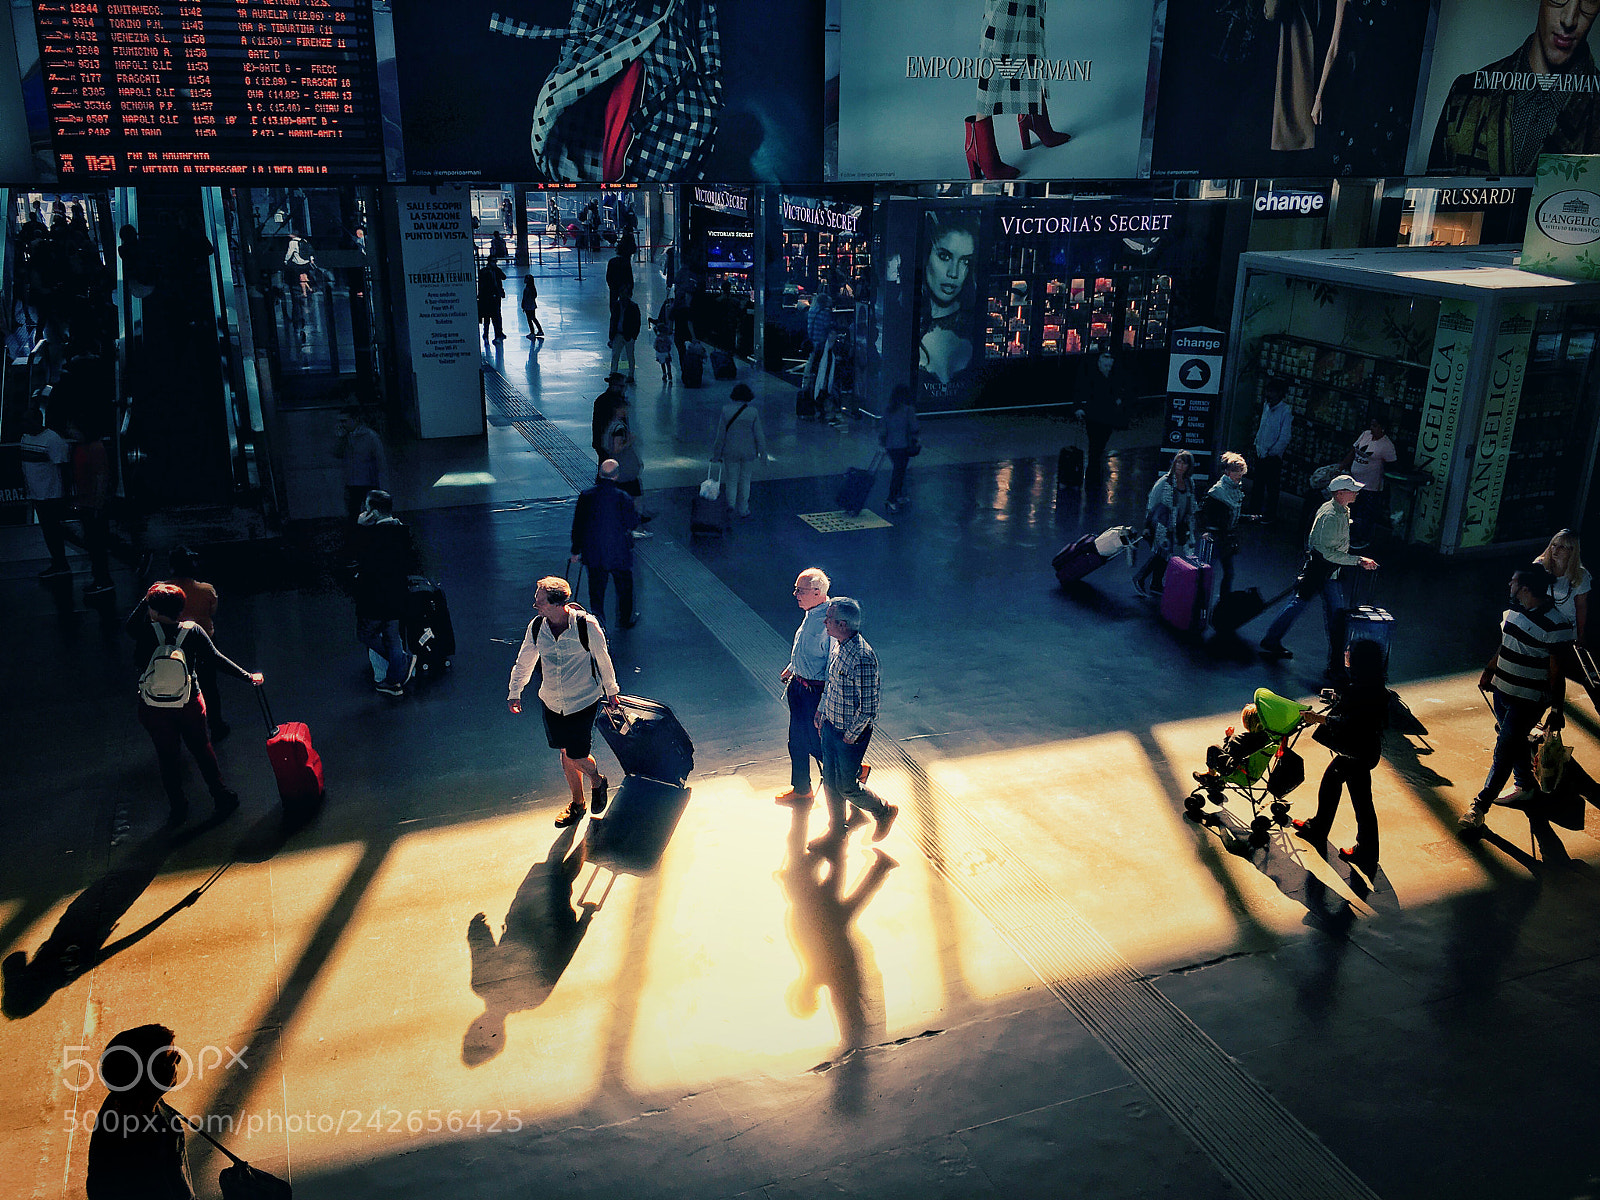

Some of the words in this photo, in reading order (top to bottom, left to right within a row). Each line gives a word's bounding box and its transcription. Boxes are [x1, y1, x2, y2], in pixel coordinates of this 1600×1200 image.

[109, 19, 141, 28] TORINO
[111, 33, 149, 42] VENEZIA
[297, 38, 332, 47] FIRENZE
[115, 61, 148, 69] NAPOLI
[905, 55, 996, 80] EMPORIO
[1019, 58, 1093, 82] ARMANI
[117, 74, 160, 83] FRASCATI
[1473, 70, 1537, 91] EMPORIO
[119, 88, 151, 96] NAPOLI
[122, 115, 154, 123] NAPOLI
[725, 191, 748, 211] SECRET
[1433, 187, 1518, 206] TRUSSARDI
[1255, 192, 1324, 214] change
[410, 212, 423, 220] LA
[423, 211, 461, 220] STAZIONE
[782, 202, 825, 227] VICTORIA'S
[826, 209, 858, 232] SECRET
[413, 222, 424, 230] DA
[440, 222, 459, 230] ALTO
[1000, 214, 1102, 235] VICTORIA'S
[1108, 214, 1172, 232] SECRET
[405, 232, 433, 240] PUNTO
[408, 273, 444, 284] TERRAZZA
[1176, 338, 1221, 350] change
[1465, 345, 1514, 527] L'ANGELICA
